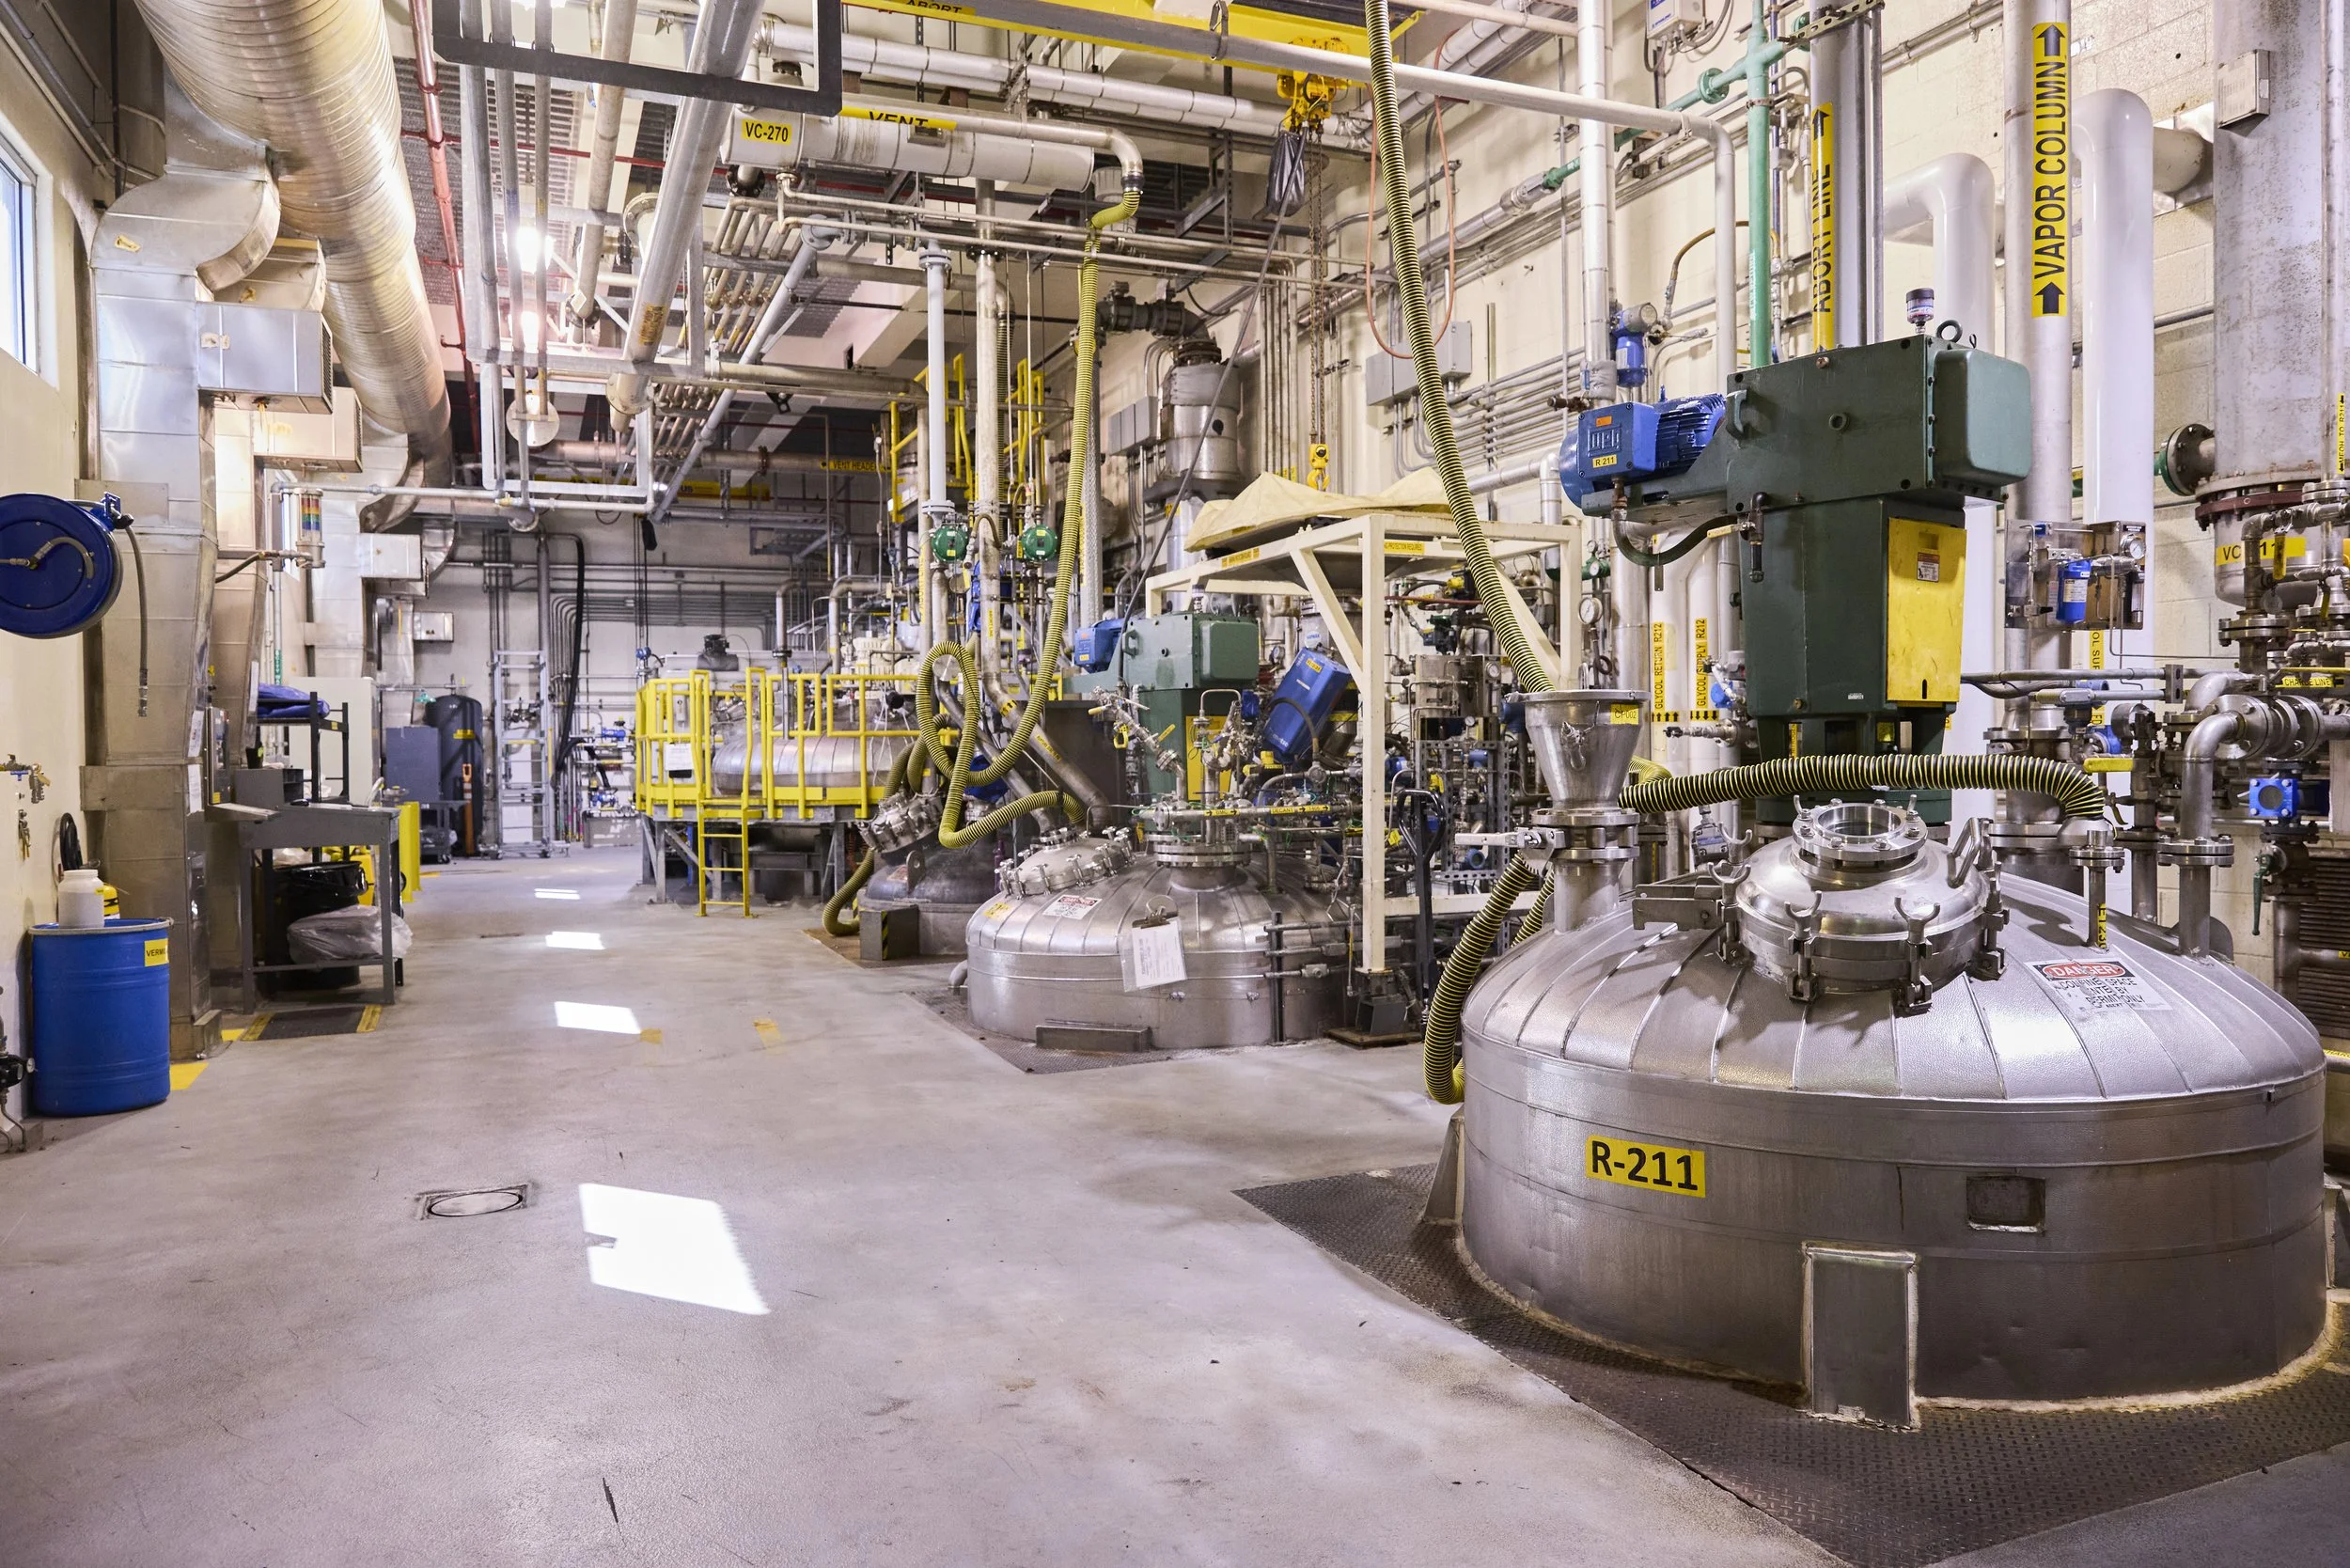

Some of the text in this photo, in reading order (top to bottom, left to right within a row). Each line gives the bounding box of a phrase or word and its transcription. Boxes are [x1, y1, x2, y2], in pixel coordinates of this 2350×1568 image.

[745, 121, 789, 142] VC-270
[2034, 61, 2066, 280] VAPOR COLUMN
[1812, 164, 1832, 313] ABORT LINE
[1602, 456, 1615, 465] 211
[1696, 619, 1705, 639] R212
[1654, 646, 1663, 676] RETURN
[1654, 680, 1663, 710] GLYCOL
[1697, 674, 1706, 707] GLYCOL
[2315, 678, 2331, 686] LINE
[2050, 963, 2117, 977] DANGER
[1591, 1139, 1699, 1191] R-211
